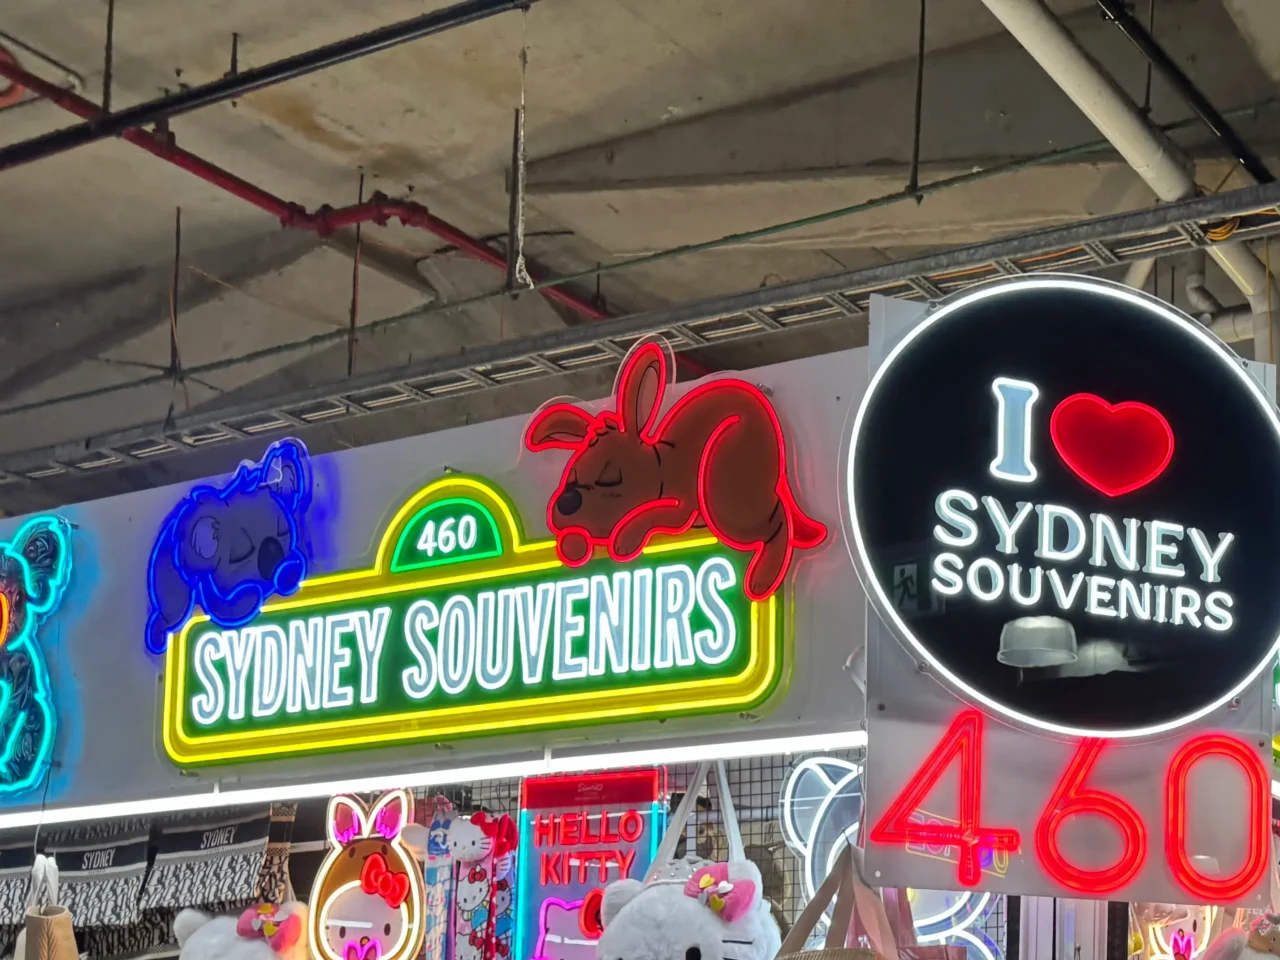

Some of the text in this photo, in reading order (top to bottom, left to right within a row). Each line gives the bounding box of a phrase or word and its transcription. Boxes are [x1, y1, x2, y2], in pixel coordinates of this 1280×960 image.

[990, 377, 1040, 483] I
[416, 514, 477, 557] 460
[933, 489, 1236, 584] SYDNEY
[930, 553, 1235, 632] SOUVENIRS
[192, 557, 737, 726] SYDNEY SOUVENIRS
[533, 808, 644, 848] HELLO
[869, 708, 1273, 901] 460
[82, 848, 116, 870] SYDNEY
[200, 826, 239, 849] SYDNEY
[540, 848, 636, 887] KITTY
